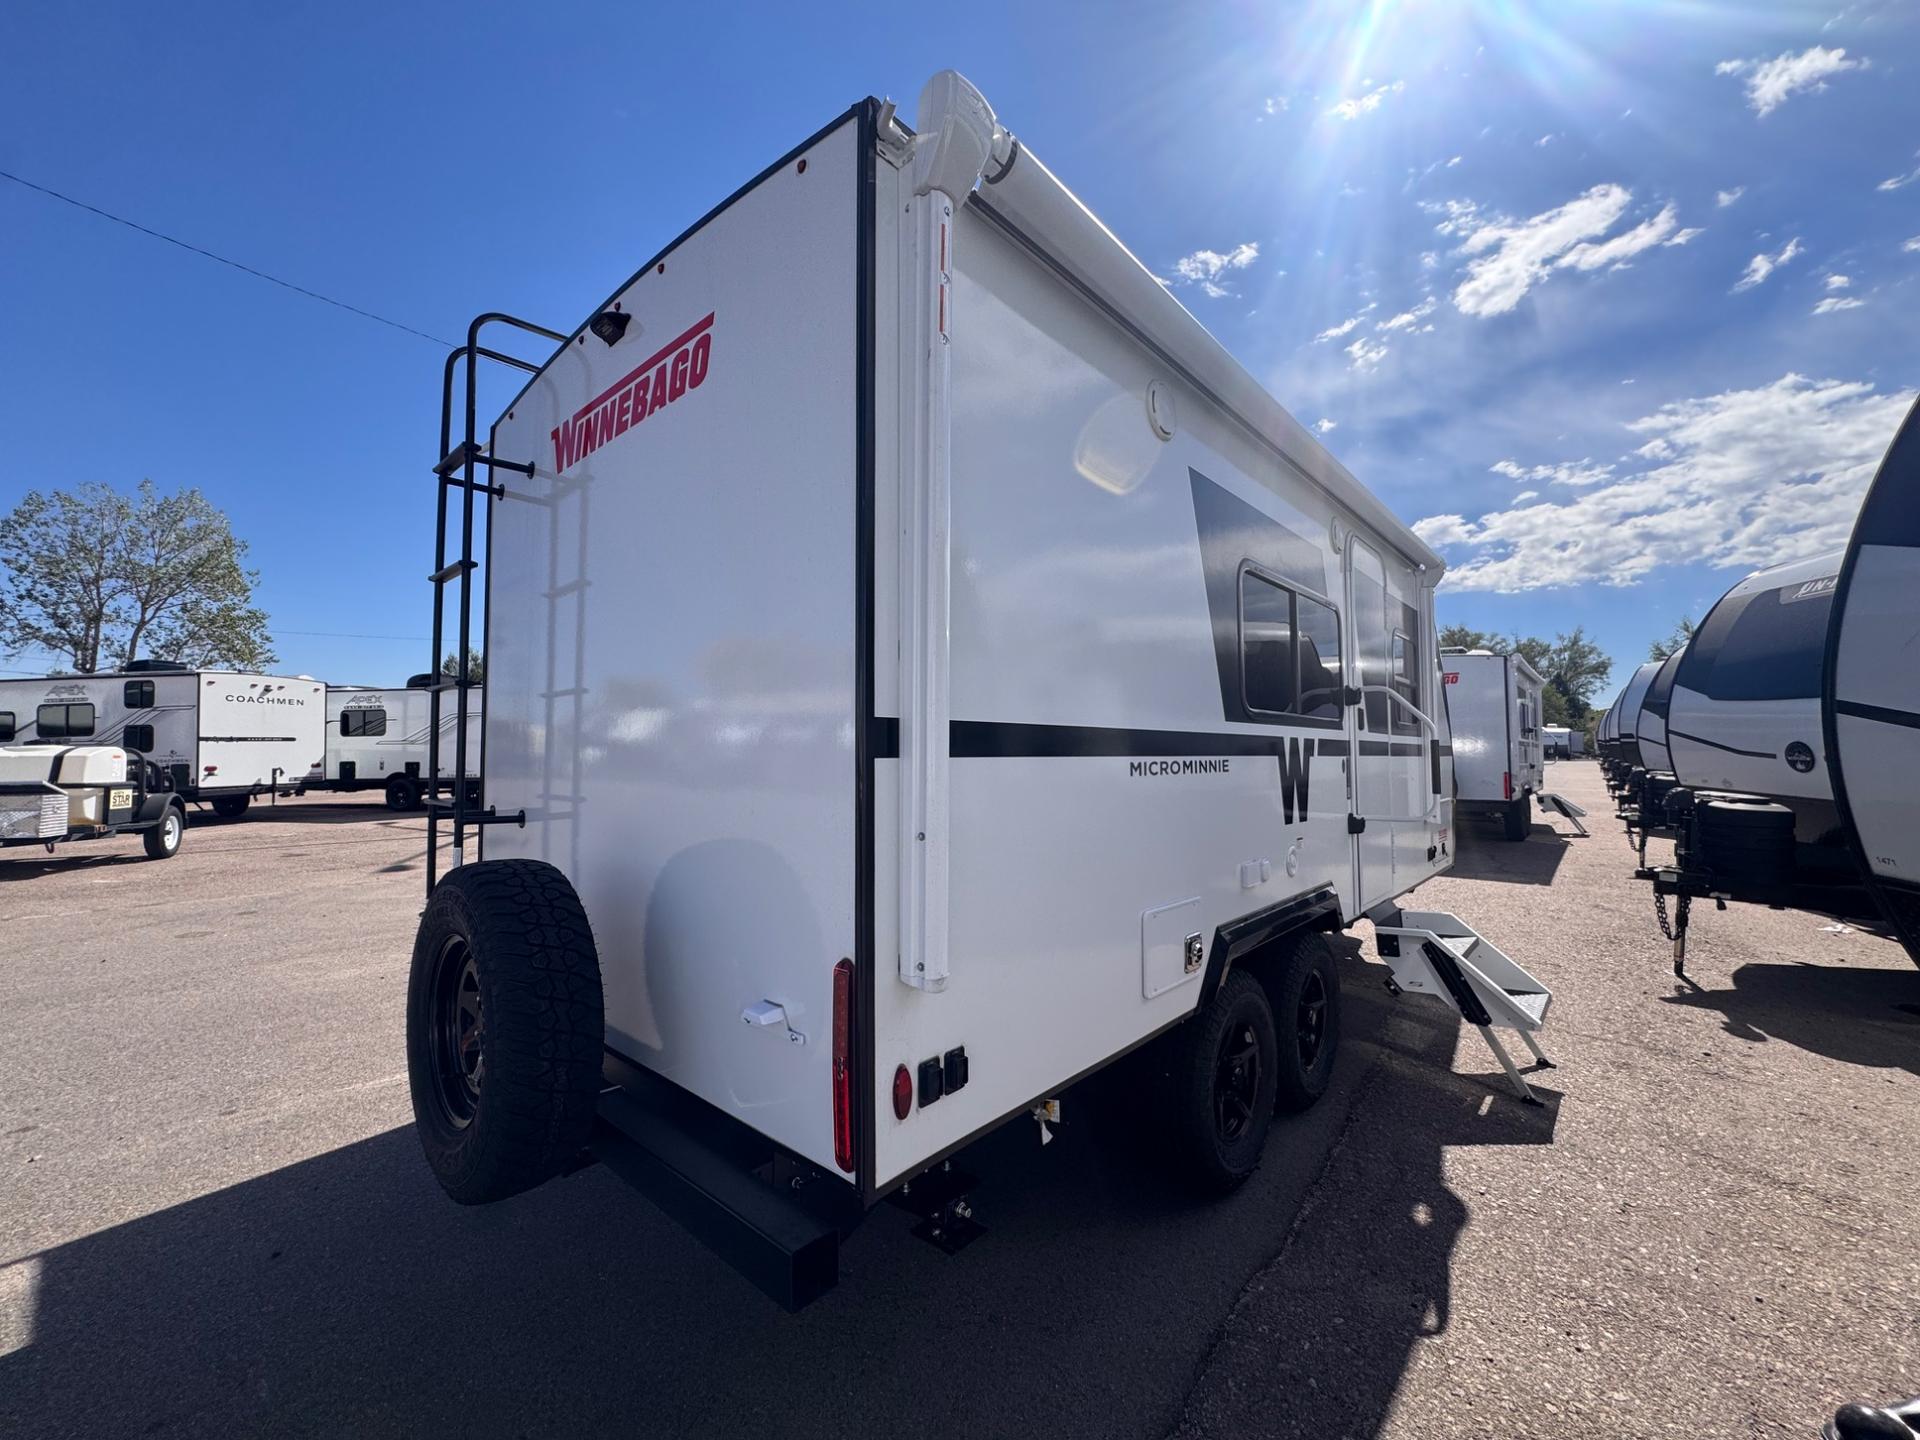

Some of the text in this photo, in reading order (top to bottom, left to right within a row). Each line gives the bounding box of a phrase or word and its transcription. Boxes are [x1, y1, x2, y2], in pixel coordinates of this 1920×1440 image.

[551, 313, 714, 474] WINNEBAGO
[225, 694, 305, 706] COACHMEN
[1129, 759, 1230, 777] MICROMINNIE
